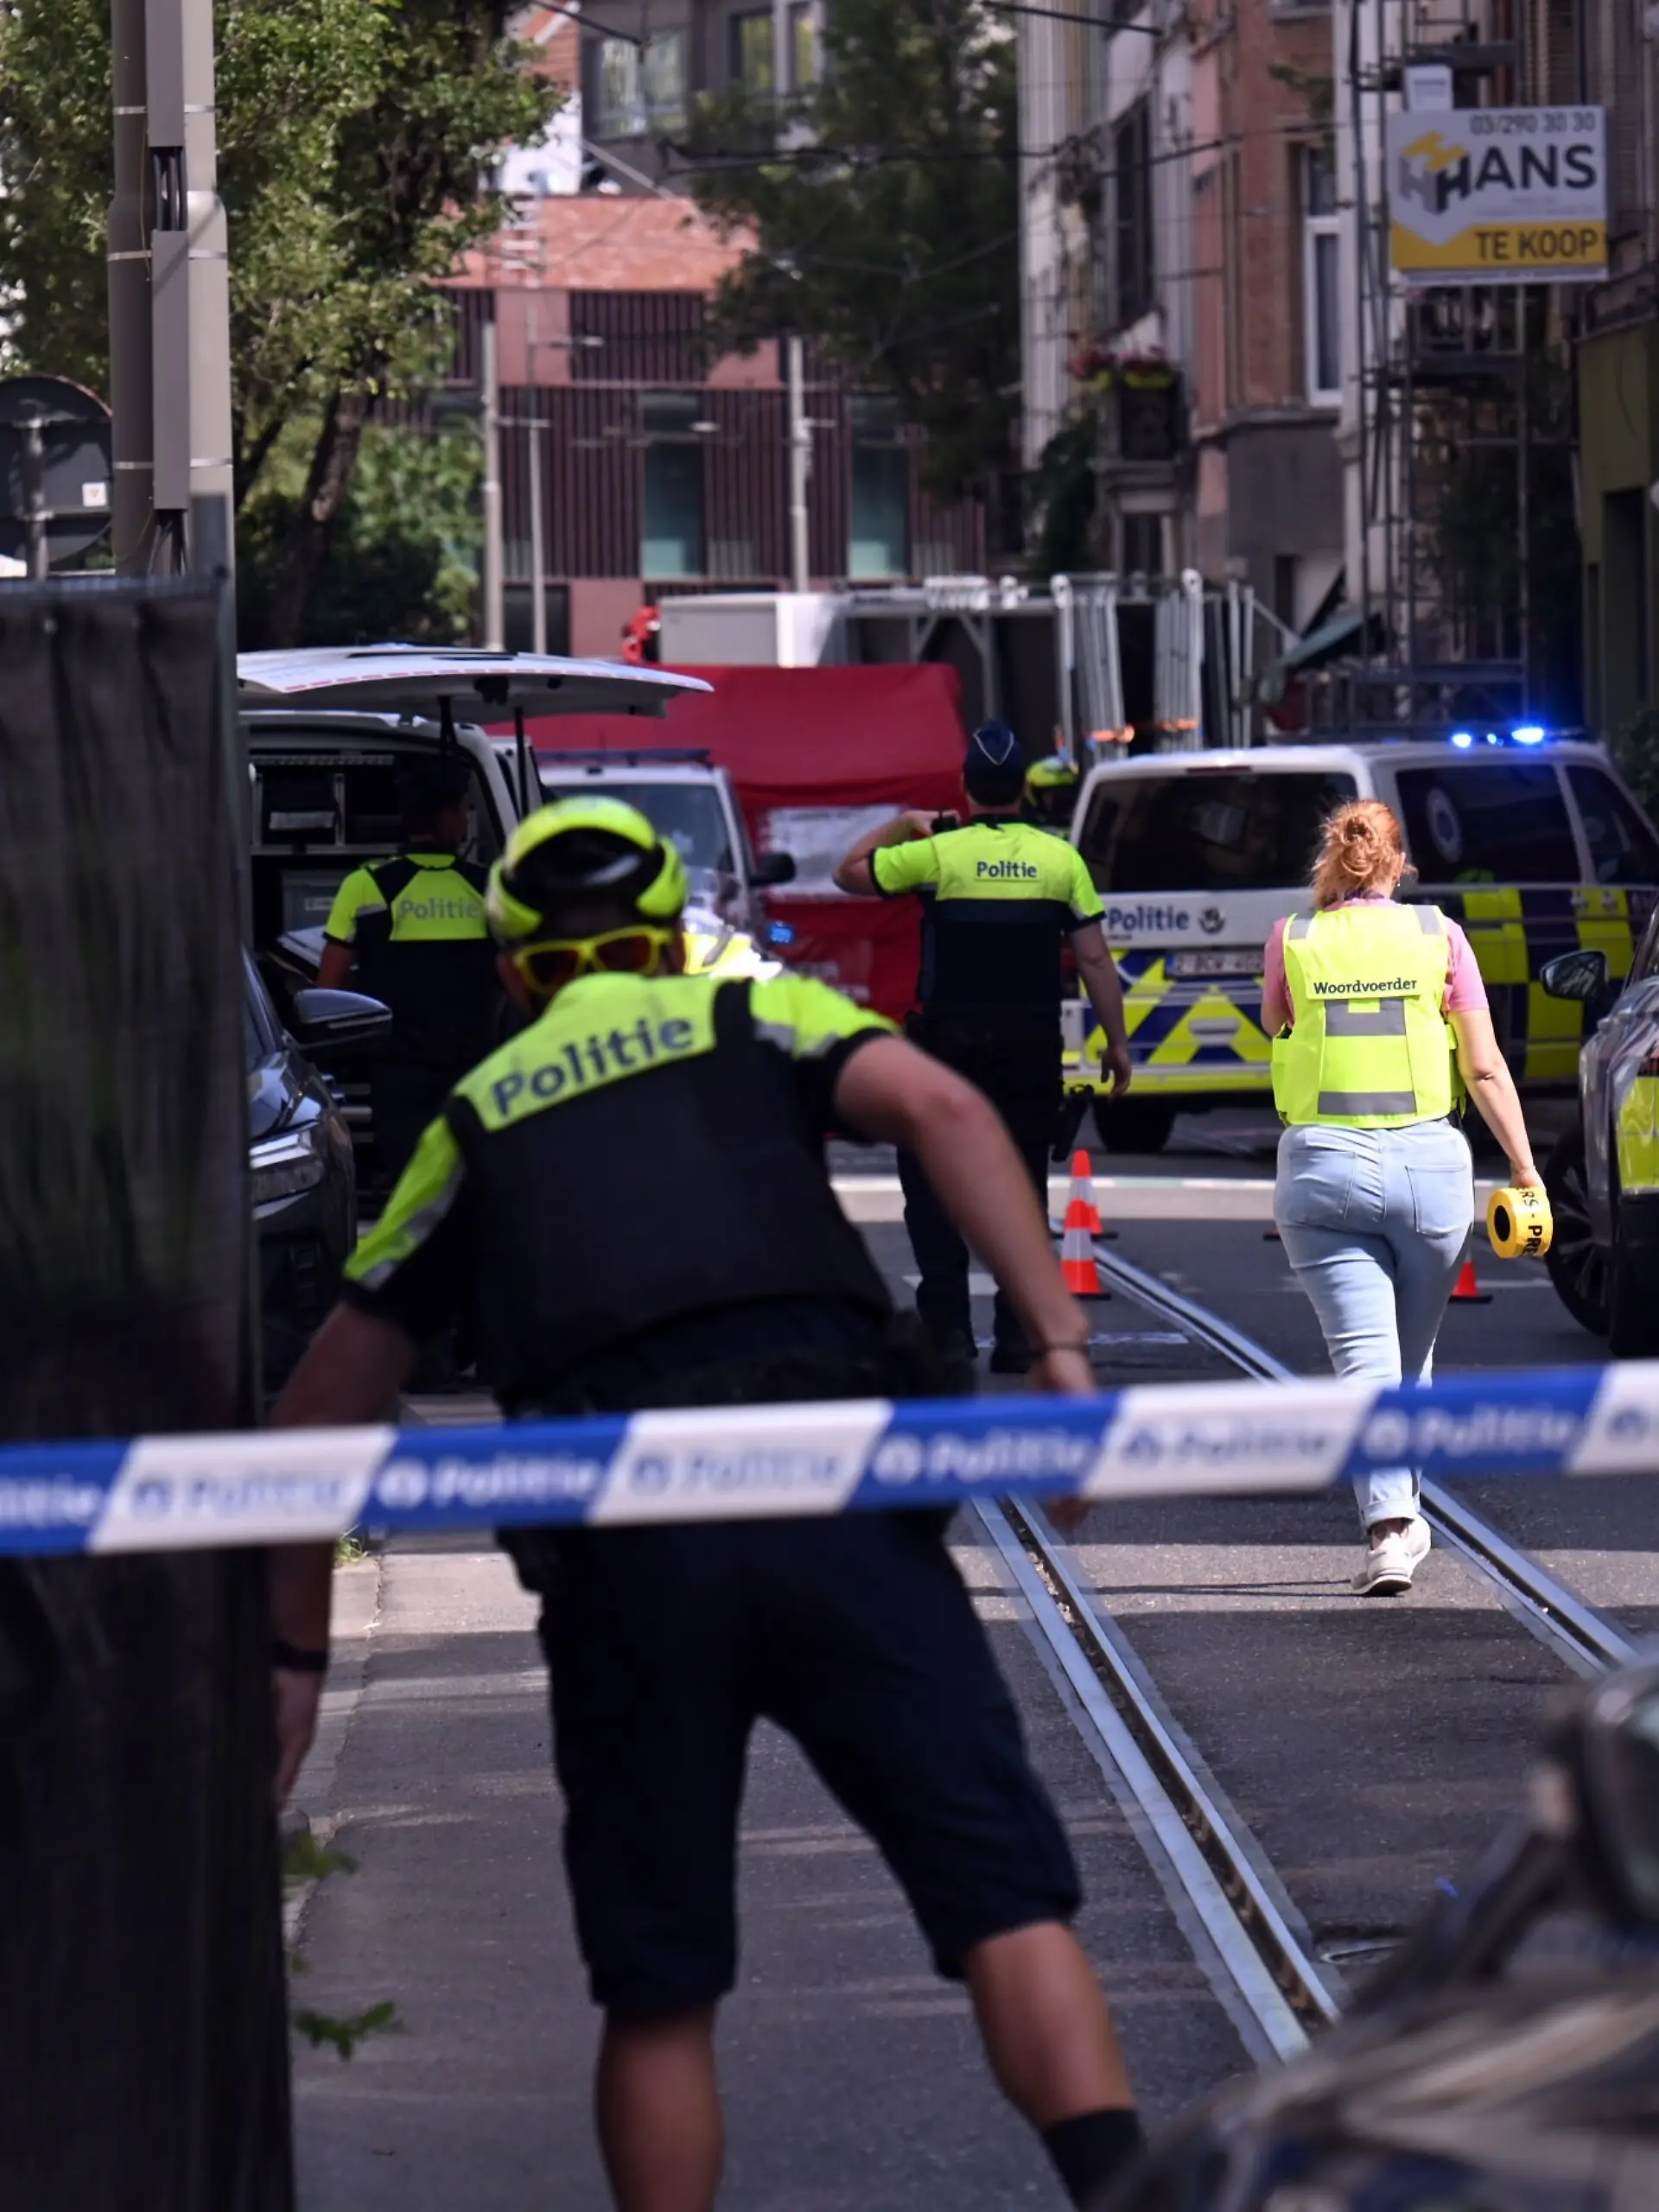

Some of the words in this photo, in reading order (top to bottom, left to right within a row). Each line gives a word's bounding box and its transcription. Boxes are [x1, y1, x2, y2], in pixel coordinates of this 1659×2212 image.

[1470, 114, 1538, 136] 03/290
[1542, 112, 1567, 134] 30
[1572, 111, 1597, 132] 30
[1475, 230, 1510, 260] TE
[1518, 228, 1599, 259] KOOP
[976, 860, 1038, 878] Politie
[401, 897, 480, 921] Politie
[1109, 904, 1190, 931] Politie
[1313, 977, 1417, 995] Woordvoerder
[492, 1019, 695, 1117] Politie
